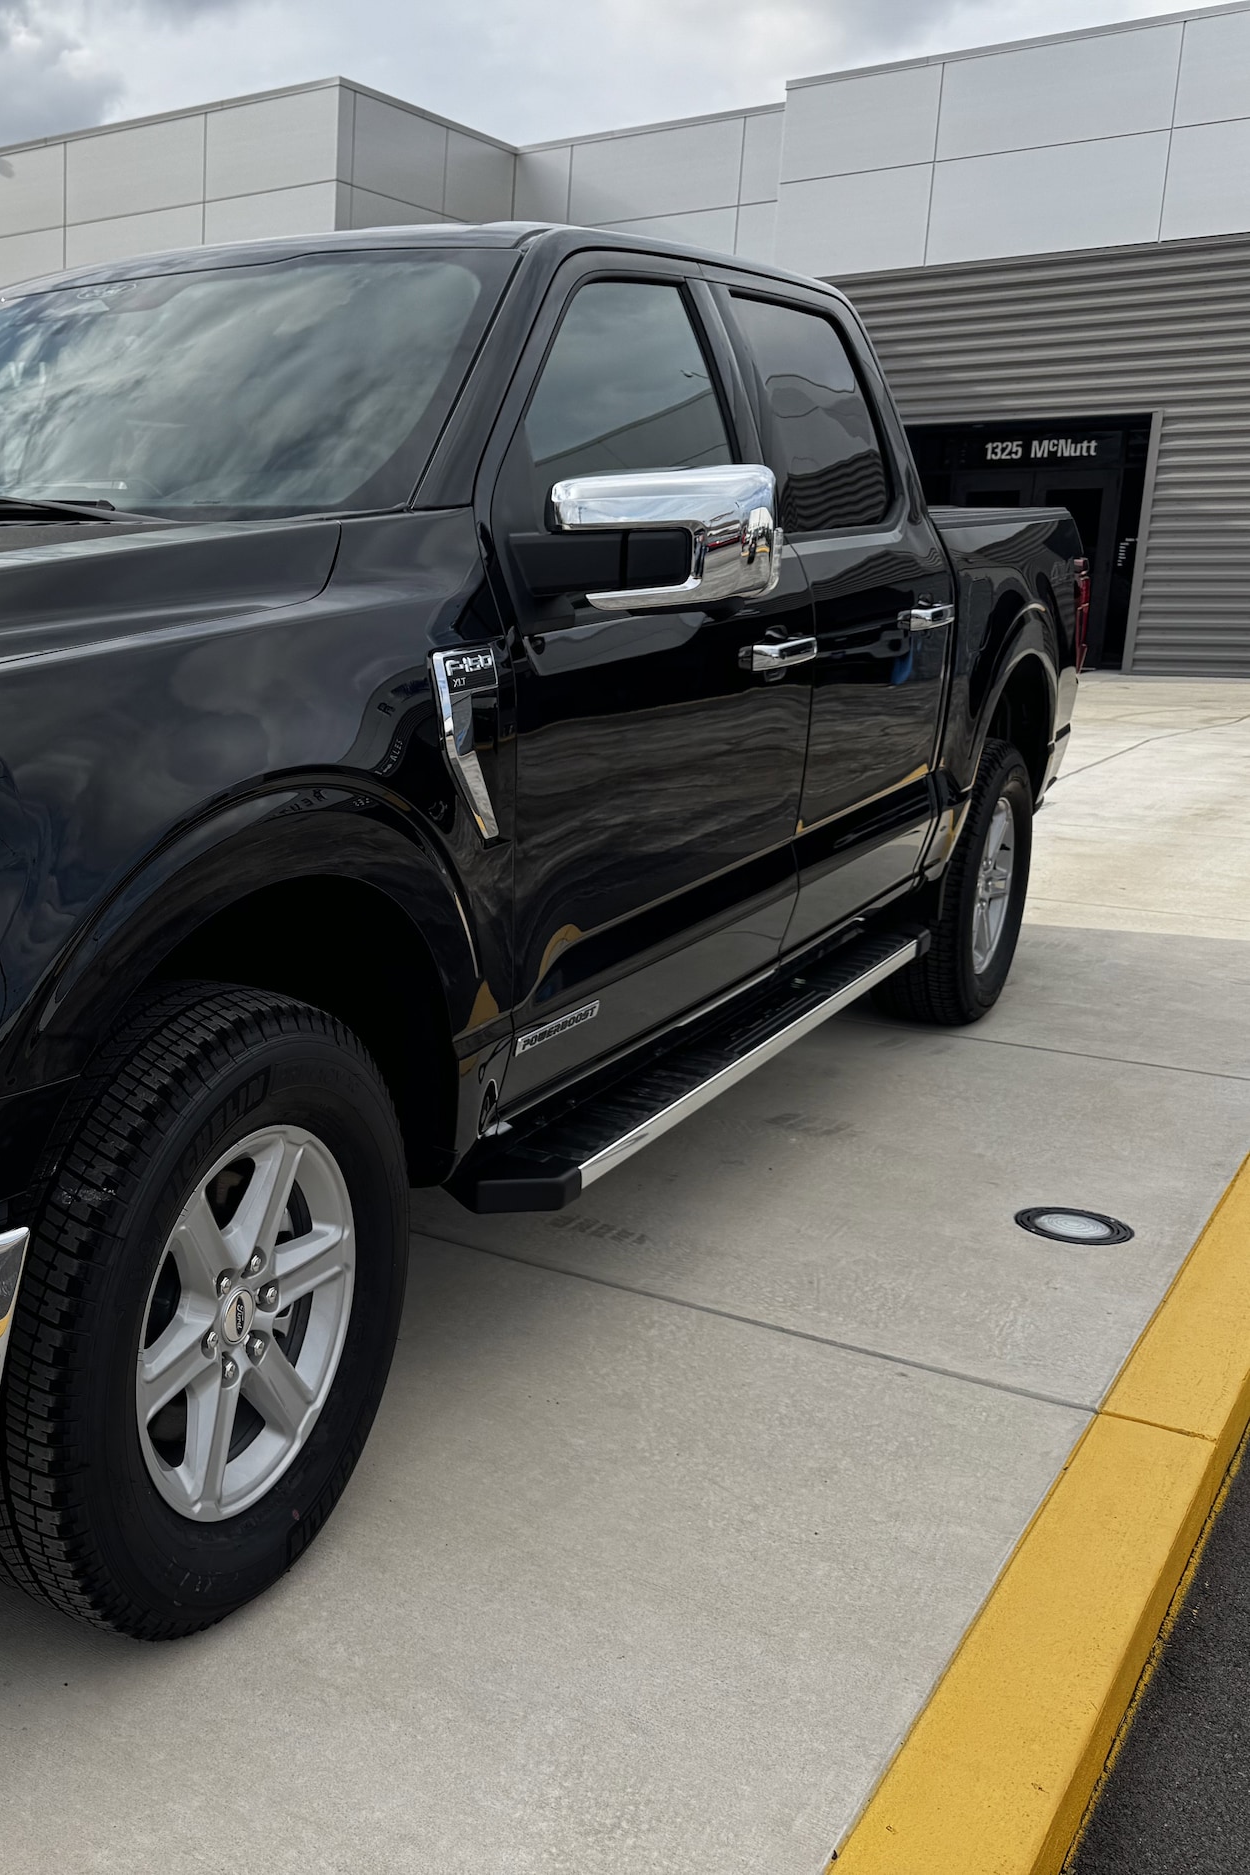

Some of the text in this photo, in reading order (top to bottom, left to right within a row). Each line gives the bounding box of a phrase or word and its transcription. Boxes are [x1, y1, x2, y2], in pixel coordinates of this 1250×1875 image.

[985, 439, 1098, 460] 1325 McNutt
[445, 655, 492, 676] F-150
[453, 677, 466, 687] XLT
[522, 1006, 597, 1050] POWERBOOST
[236, 1304, 244, 1330] Ford
